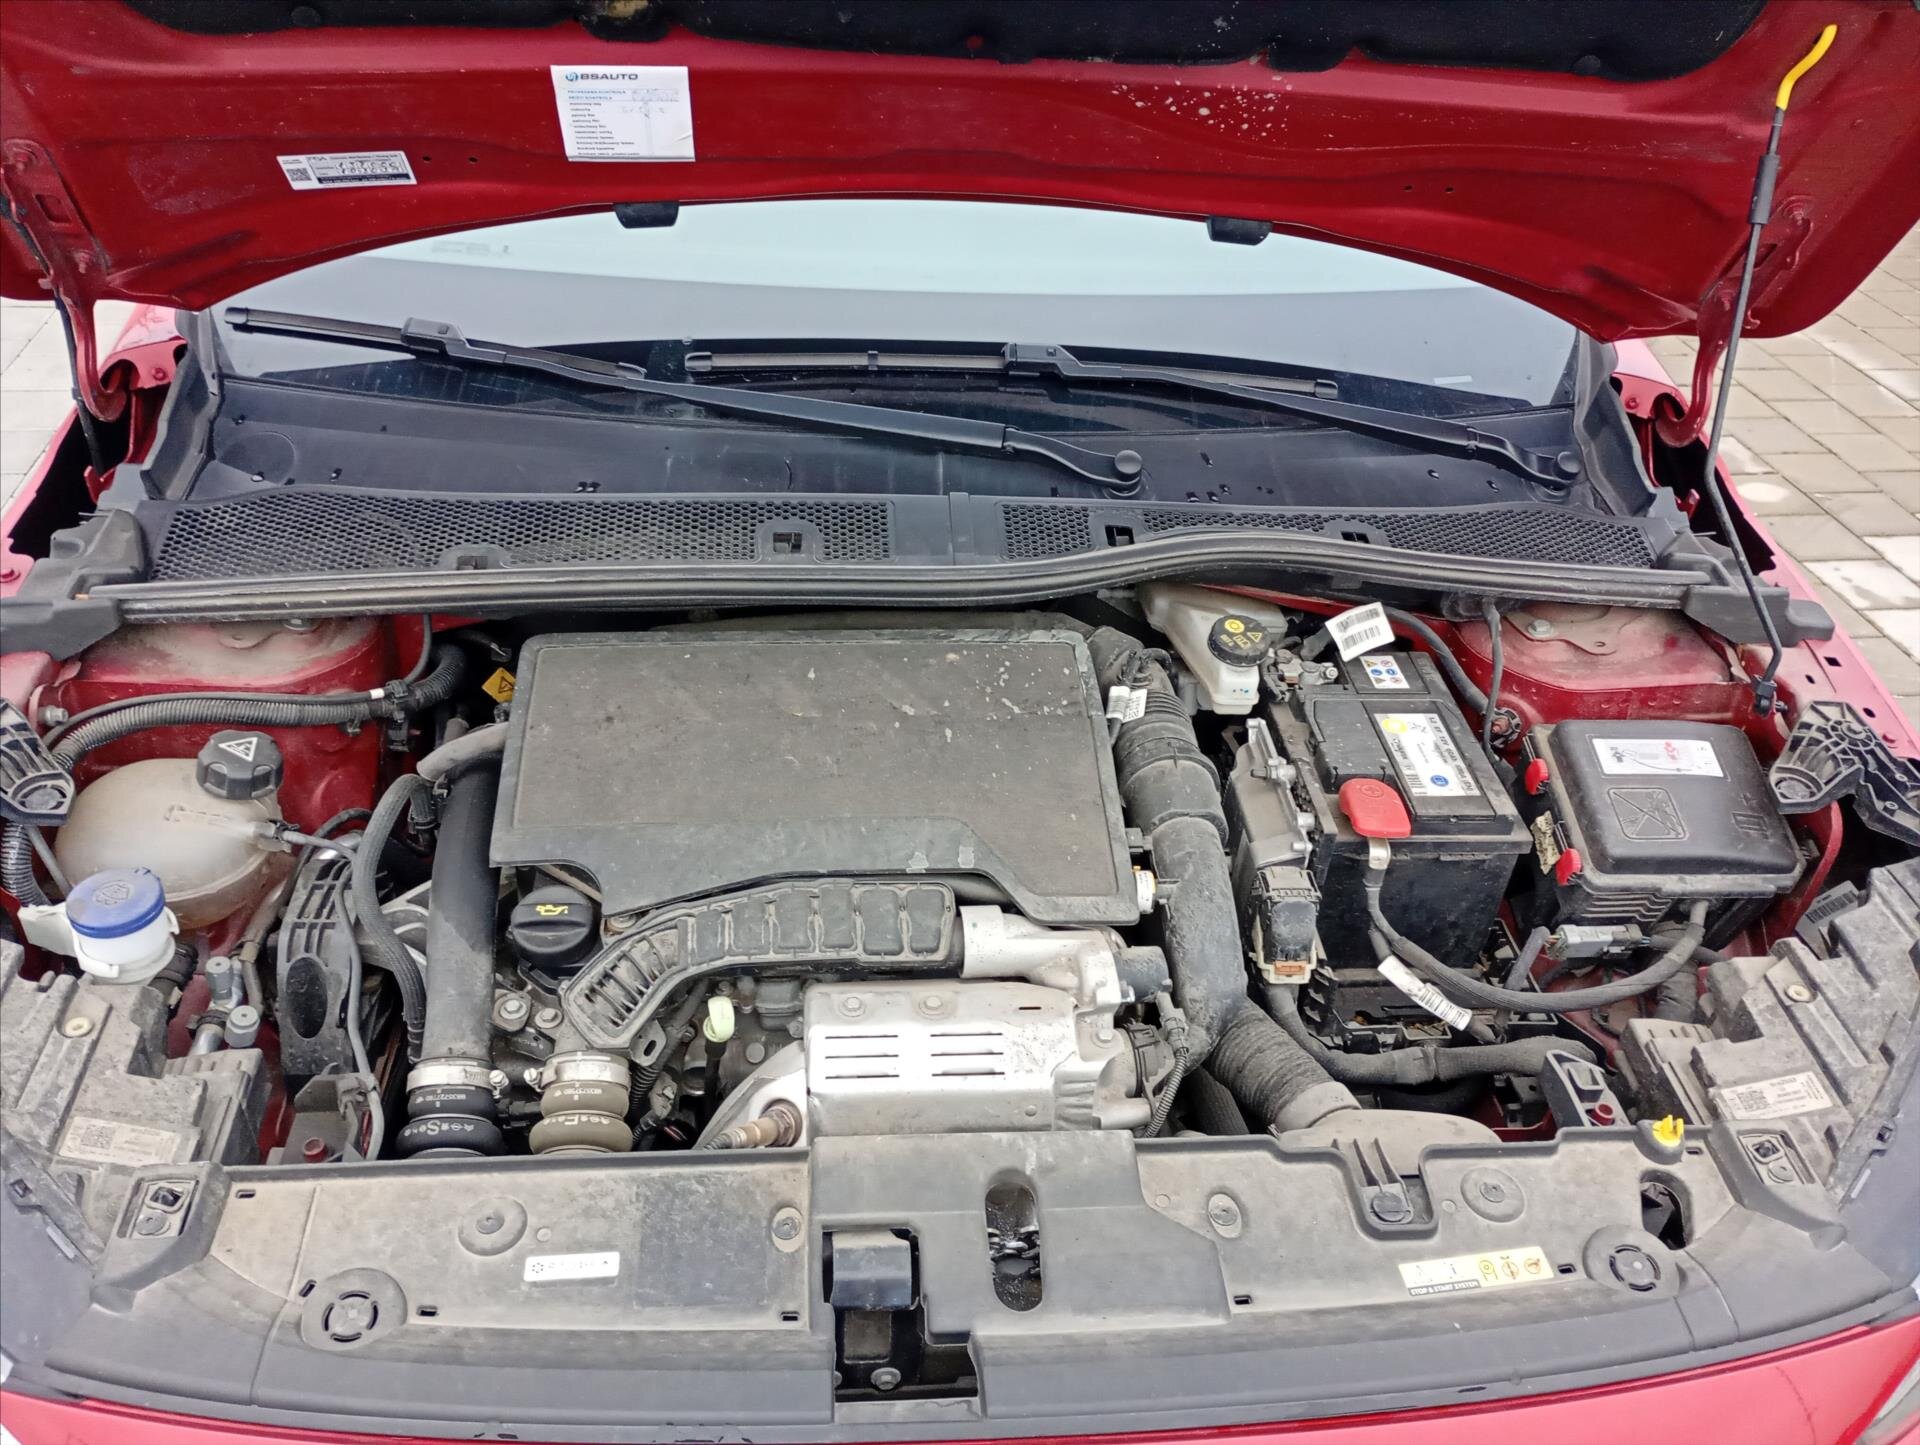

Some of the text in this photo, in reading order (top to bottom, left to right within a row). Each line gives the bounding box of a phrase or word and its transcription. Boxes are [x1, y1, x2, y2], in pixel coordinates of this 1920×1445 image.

[580, 73, 638, 81] BSAUTO
[1410, 1287, 1427, 1296] STOP
[1454, 1282, 1478, 1290] SYSTEM
